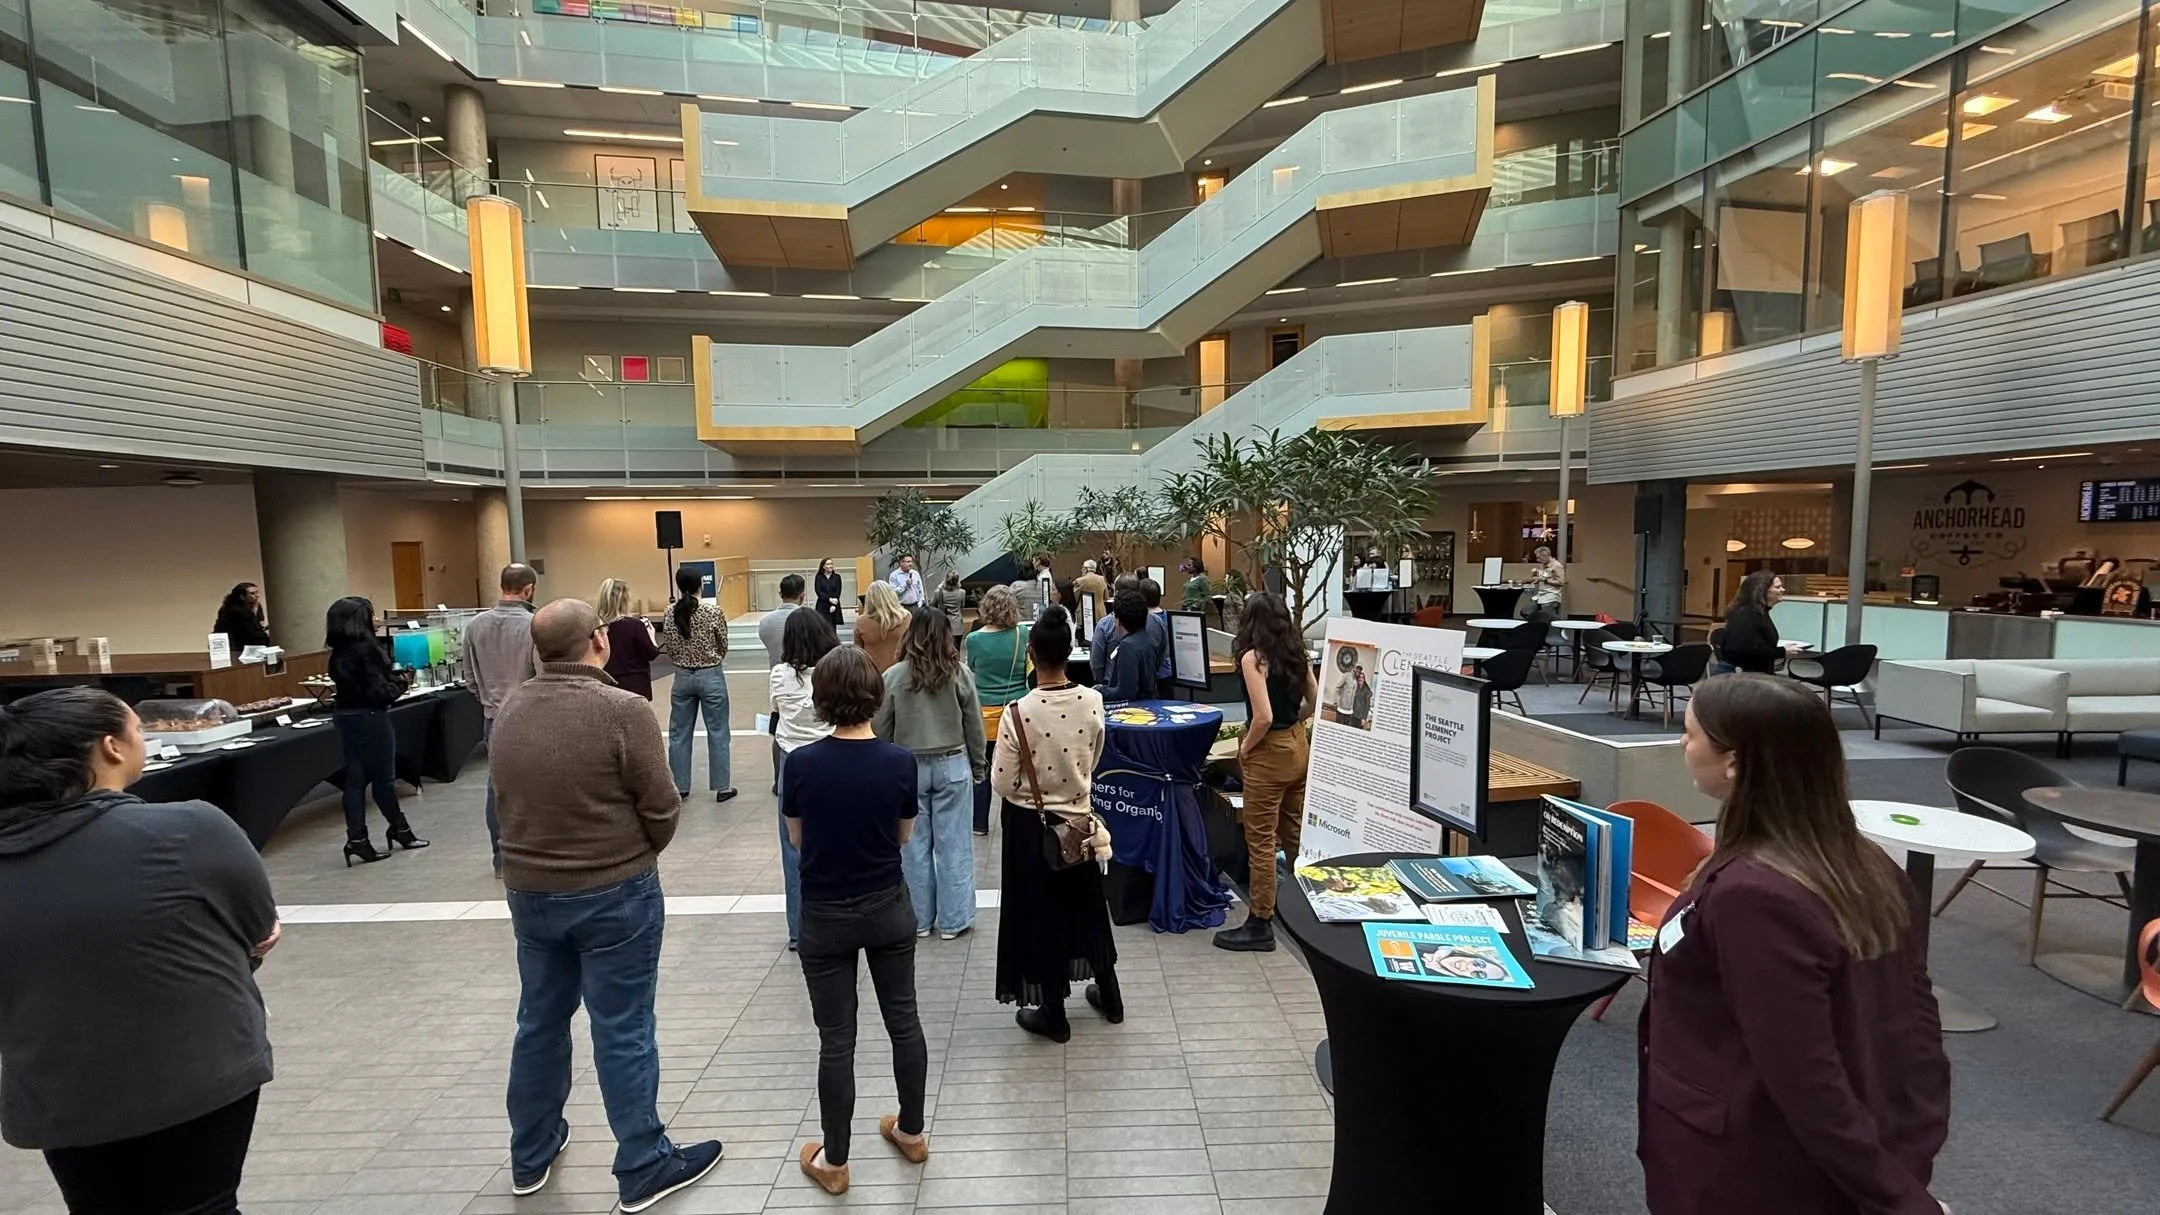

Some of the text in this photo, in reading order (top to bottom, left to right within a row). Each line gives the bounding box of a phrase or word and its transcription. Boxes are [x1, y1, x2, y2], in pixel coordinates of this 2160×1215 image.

[1912, 507, 2026, 530] ANCHORHEAD
[1414, 652, 1449, 664] SEATTLE
[1424, 722, 1457, 738] CLEMENCY
[1425, 714, 1465, 731] THE SEATTLE
[1424, 731, 1451, 744] PROJECT
[1119, 786, 1135, 799] for
[1318, 818, 1351, 839] Microsoft
[1376, 929, 1492, 944] JUVENILE PAROLE PROJECT
